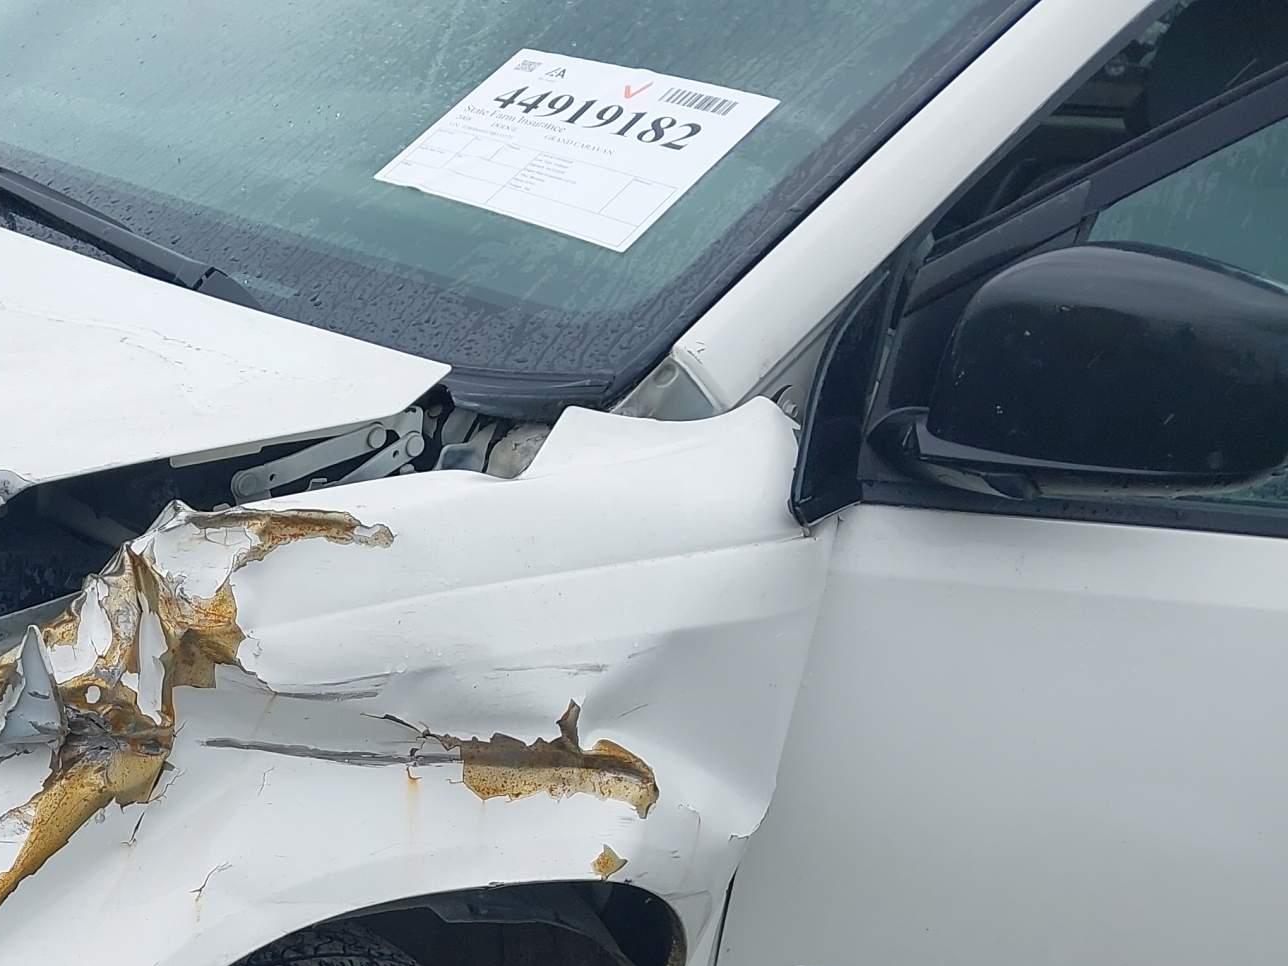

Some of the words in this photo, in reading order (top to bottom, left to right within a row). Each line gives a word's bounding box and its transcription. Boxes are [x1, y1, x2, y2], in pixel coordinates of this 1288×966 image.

[464, 104, 489, 117] State
[490, 110, 516, 122] Farm
[517, 116, 567, 133] Insurance
[494, 86, 702, 151] 44919182
